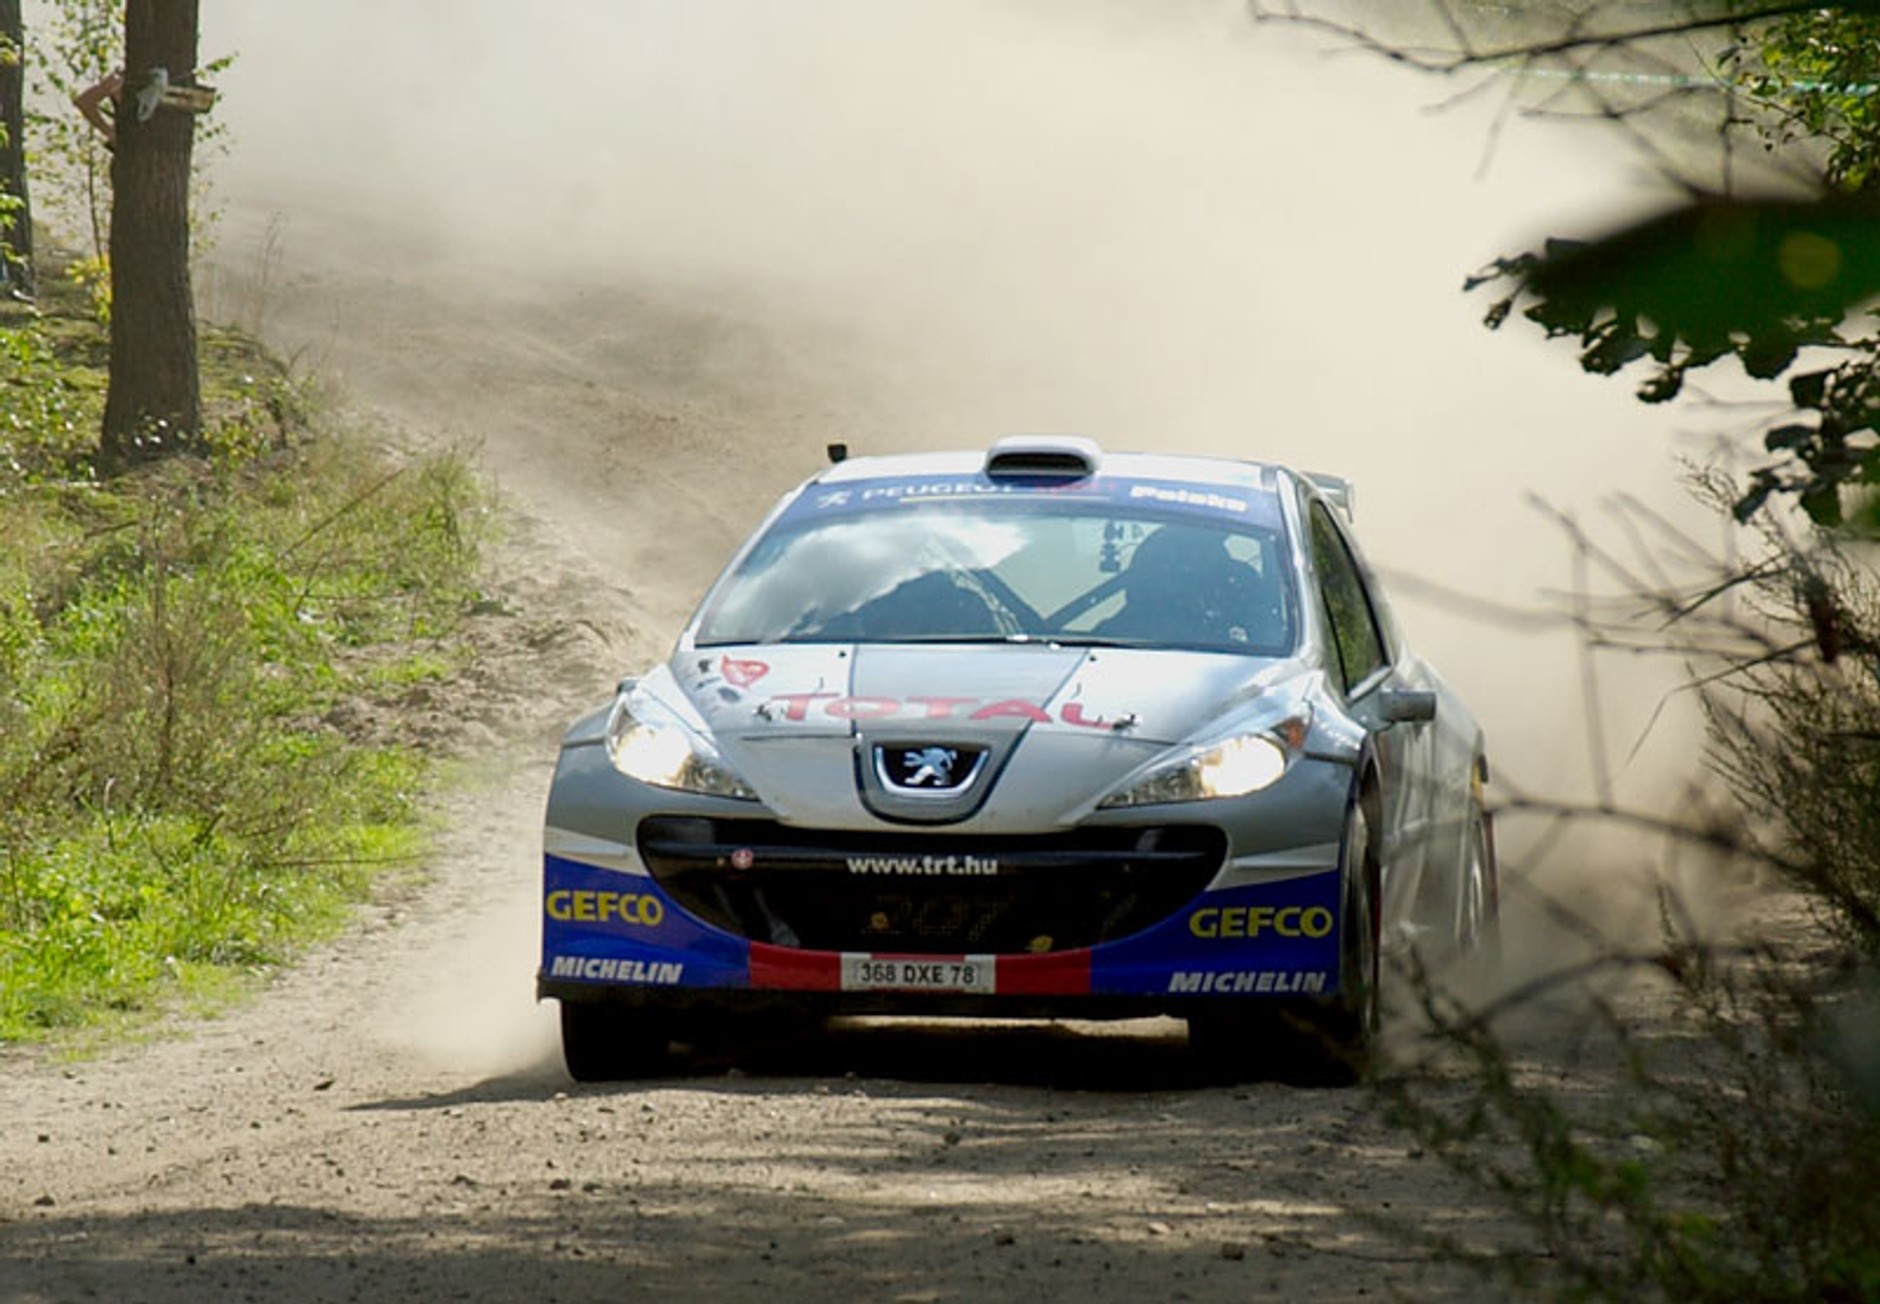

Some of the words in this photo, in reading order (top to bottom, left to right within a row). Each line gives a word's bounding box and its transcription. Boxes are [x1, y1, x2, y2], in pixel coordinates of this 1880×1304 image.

[771, 693, 1114, 729] TOTAL
[847, 855, 998, 875] www.trt.hu
[546, 890, 663, 926] GEFCO
[1189, 906, 1333, 938] GEFCO
[551, 956, 683, 983] MICHELIN
[861, 963, 896, 983] 368
[903, 965, 943, 984] DXE
[951, 966, 975, 984] 78
[1168, 971, 1326, 994] MICHELIN
